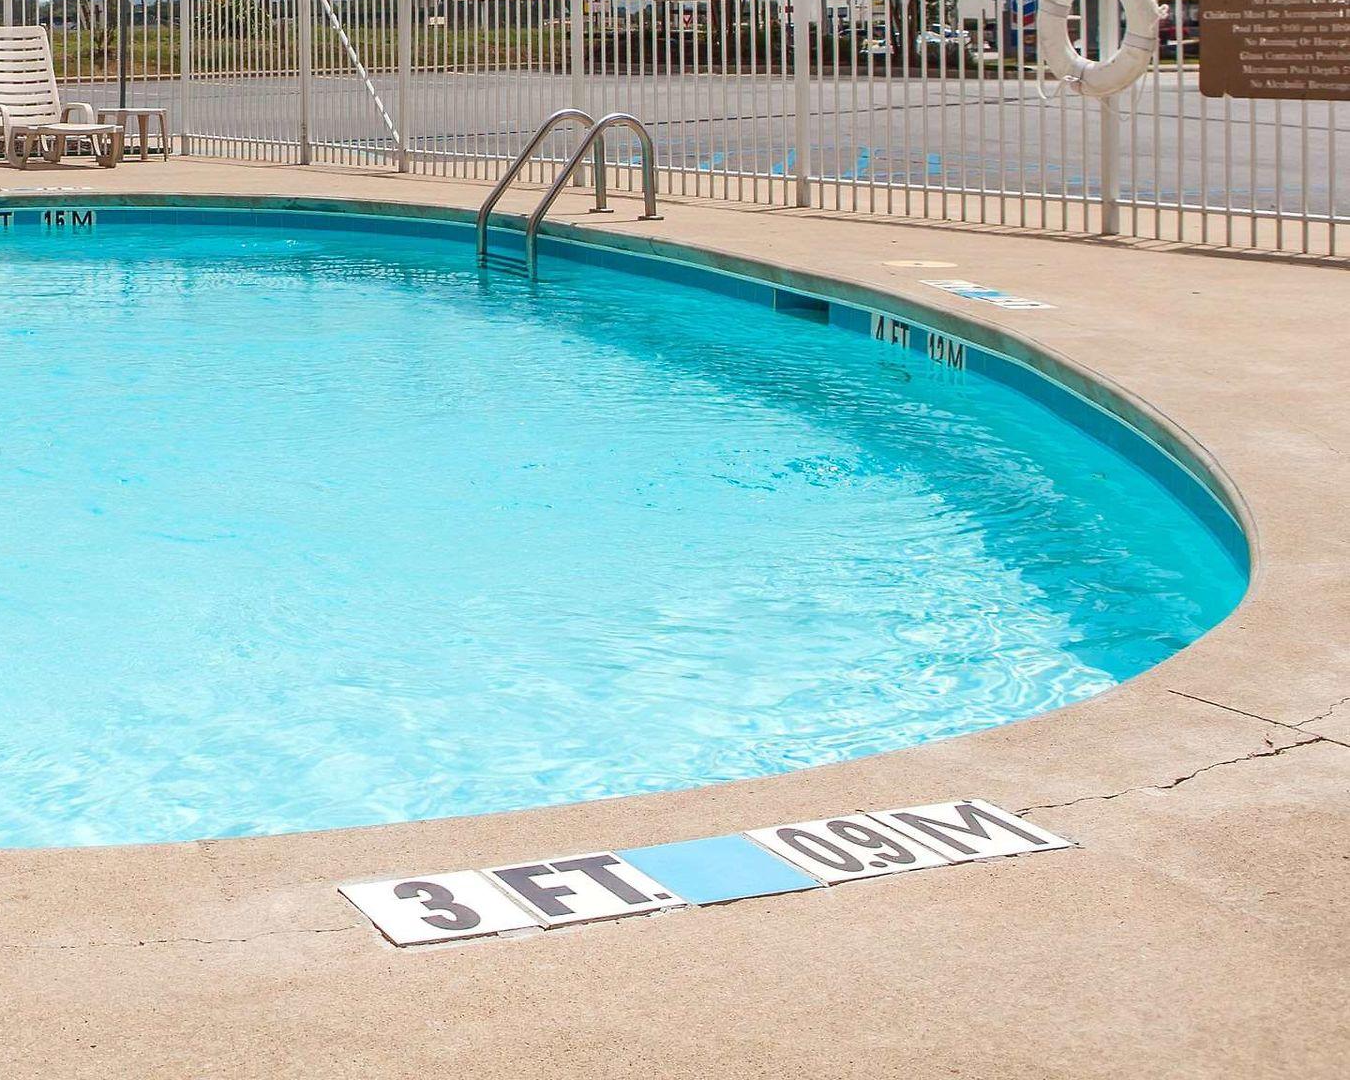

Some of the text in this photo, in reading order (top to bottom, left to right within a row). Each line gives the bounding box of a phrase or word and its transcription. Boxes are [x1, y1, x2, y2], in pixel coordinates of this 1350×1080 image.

[891, 318, 909, 349] FT
[393, 804, 1049, 931] 3 FT. 0.9 M
